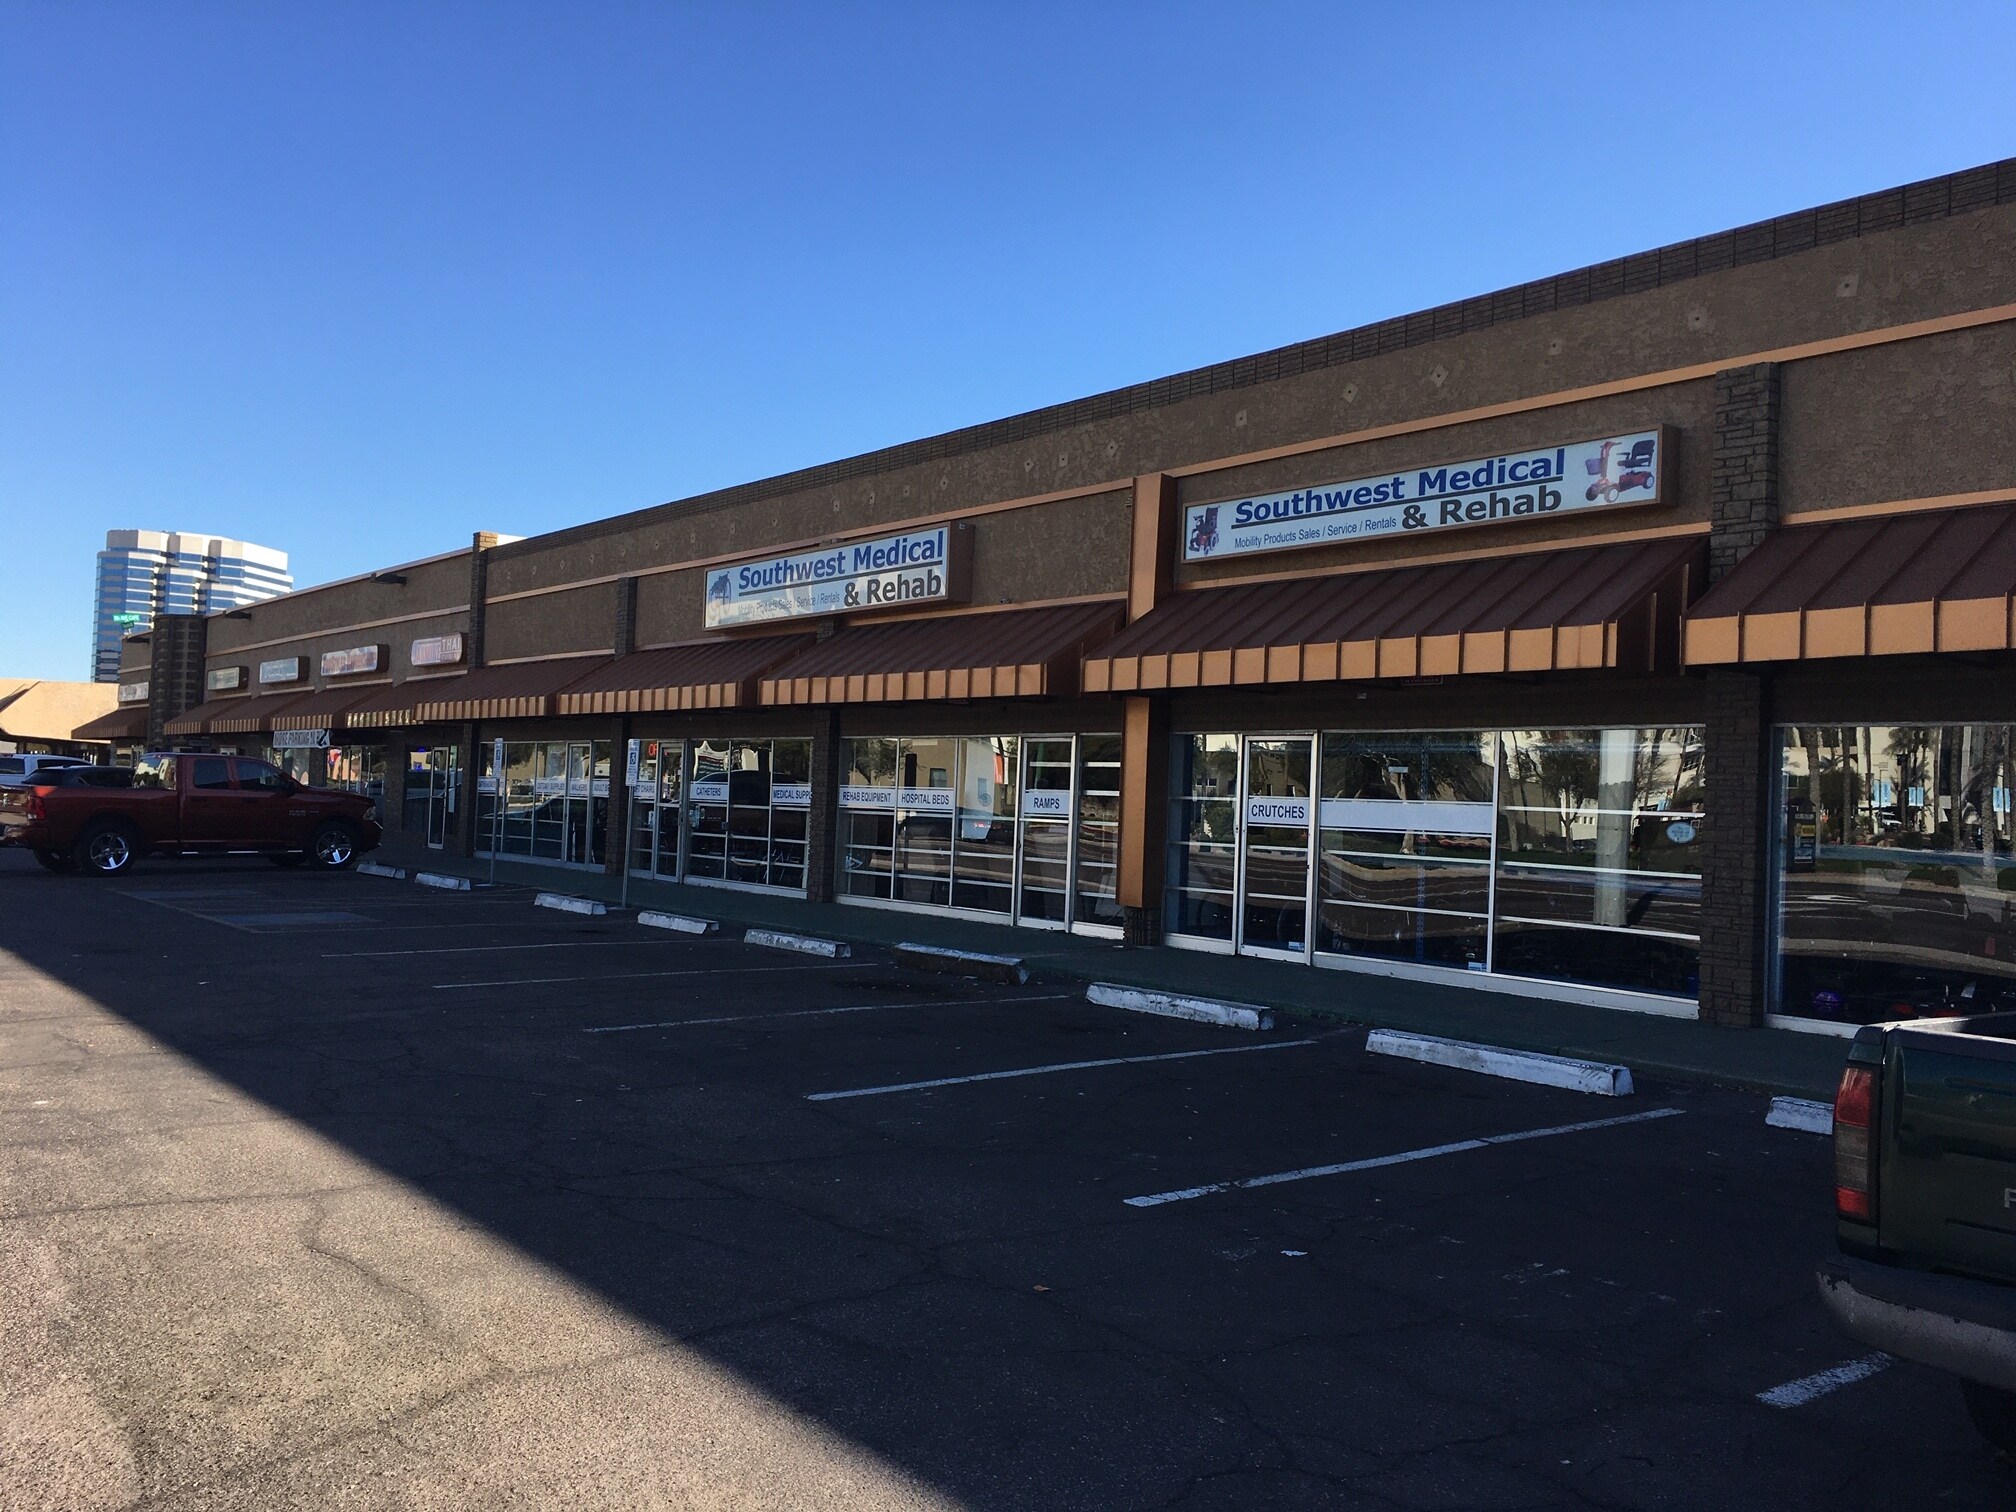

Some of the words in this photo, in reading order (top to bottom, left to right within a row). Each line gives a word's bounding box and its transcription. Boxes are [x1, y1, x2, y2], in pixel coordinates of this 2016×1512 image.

[1235, 476, 1405, 523] Southwest
[1418, 448, 1565, 496] Medical
[1402, 504, 1429, 529] &
[1440, 485, 1561, 525] Rehab
[1235, 536, 1262, 549] Mobility
[1264, 531, 1296, 545] Products
[1299, 528, 1320, 541] Sales
[1327, 523, 1357, 537] Service
[1365, 517, 1397, 531] Rentals
[739, 551, 846, 590] Southwest
[853, 530, 943, 572] Medical
[844, 582, 861, 607] &
[867, 569, 942, 604] Rehab
[797, 596, 816, 608] Service
[820, 592, 840, 605] Rentals
[442, 637, 460, 651] THAI
[696, 787, 722, 797] CATHETERS
[773, 789, 795, 799] MEDICAL
[843, 791, 861, 801] REHAB
[861, 792, 892, 803] EQUIPMENT
[901, 793, 931, 804] HOSPITAL
[932, 794, 950, 805] BEDS
[1034, 797, 1060, 809] RAMPS
[1251, 804, 1305, 819] CRUTCHES
